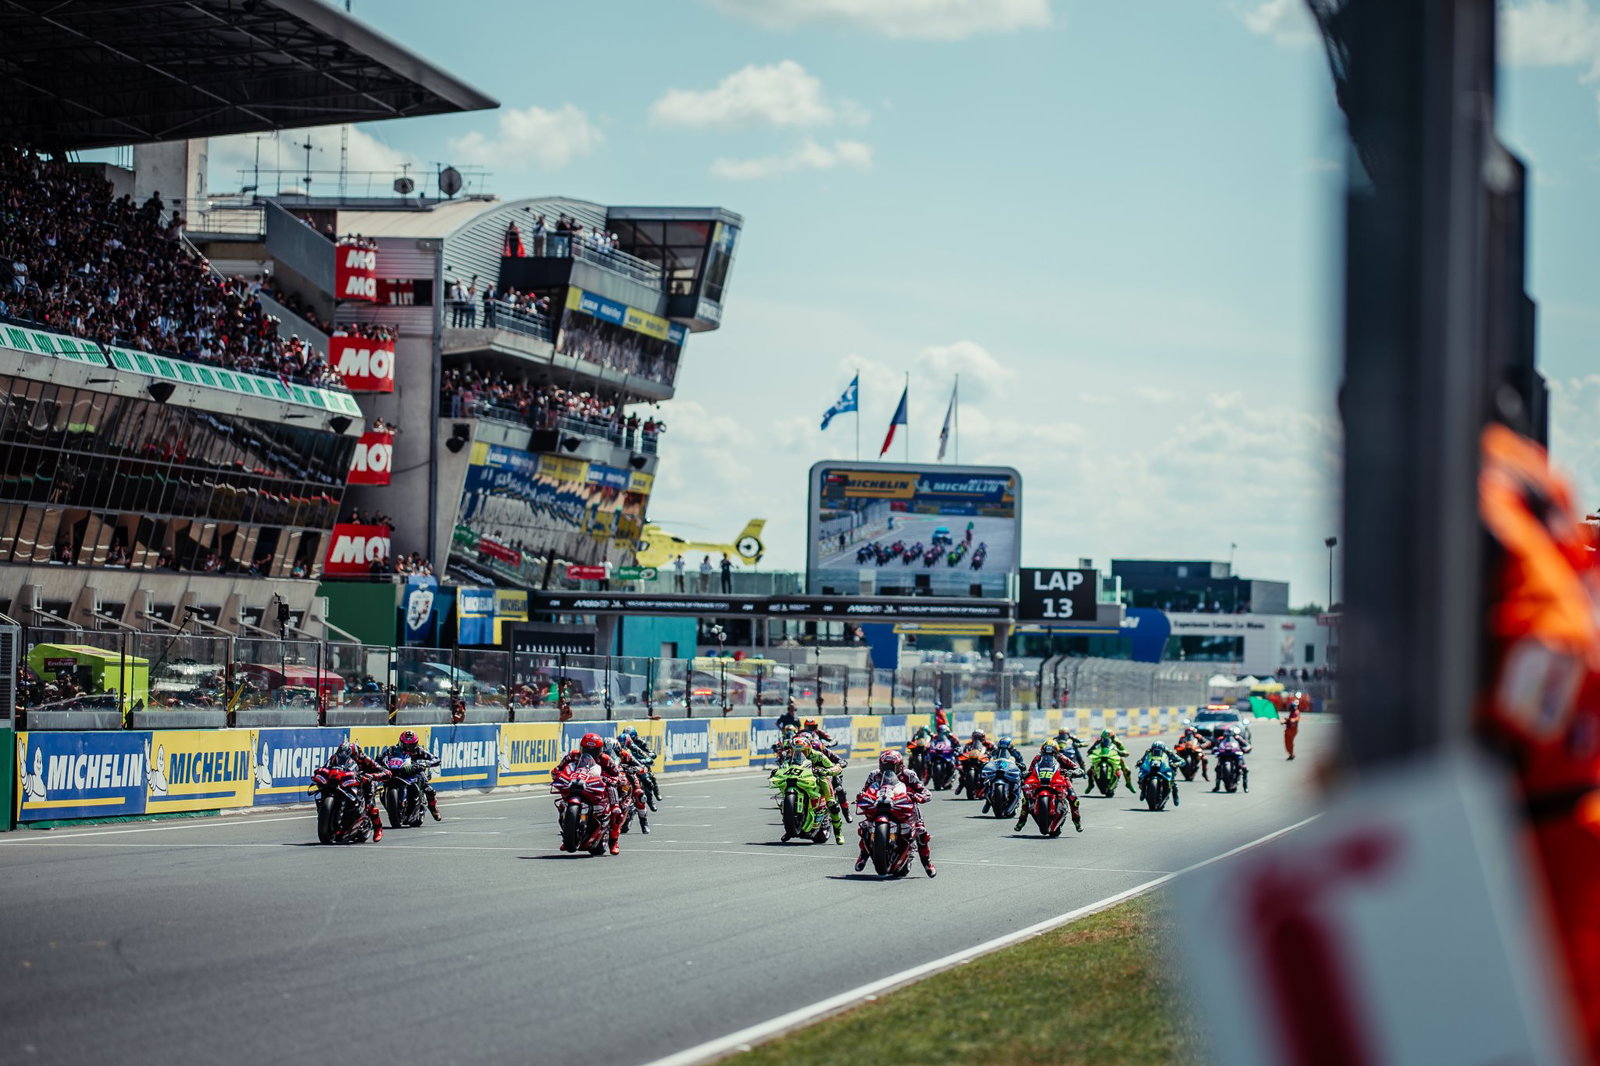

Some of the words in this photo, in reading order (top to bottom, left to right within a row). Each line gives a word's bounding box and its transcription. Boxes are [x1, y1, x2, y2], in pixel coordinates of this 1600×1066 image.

[1034, 571, 1083, 591] LAP
[1043, 598, 1073, 618] 13
[511, 739, 558, 764] MICHELIN
[673, 731, 708, 754] MICHELIN
[717, 731, 748, 751] MICHELIN
[441, 741, 496, 769] MICHELIN
[47, 753, 143, 790] MICHELIN
[169, 750, 250, 785] MICHELIN
[783, 768, 804, 776] 49
[1038, 771, 1054, 779] 36
